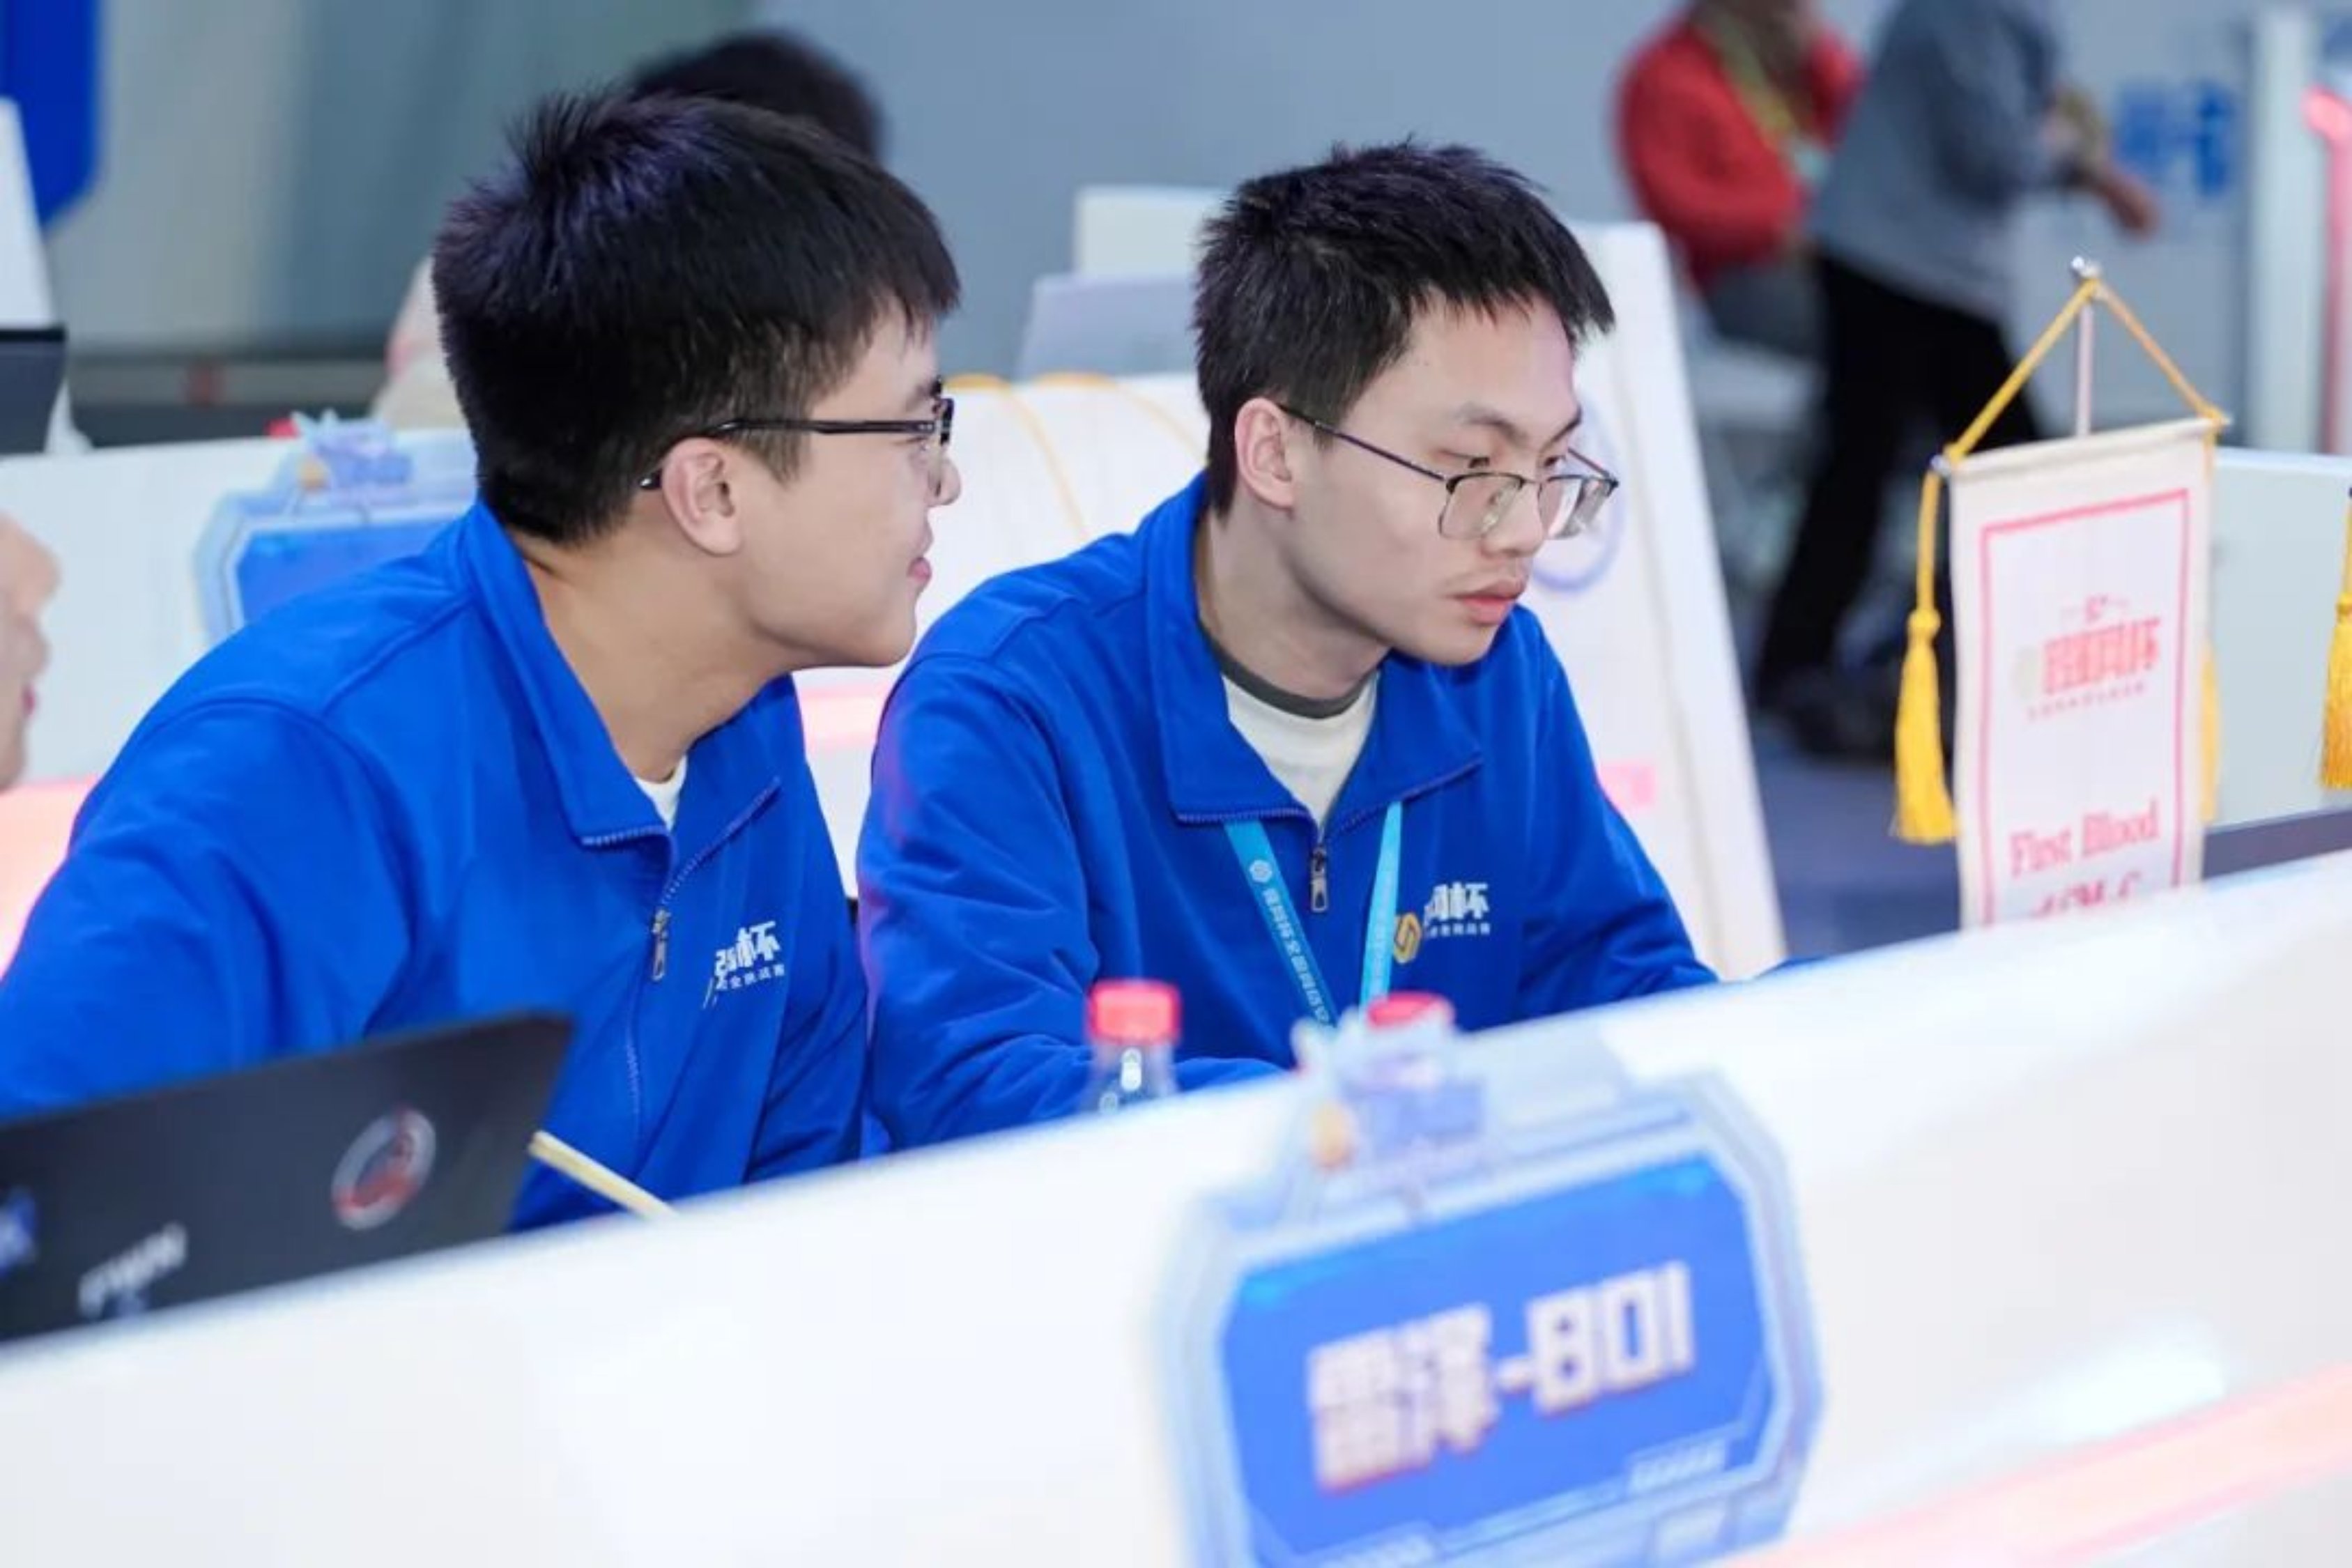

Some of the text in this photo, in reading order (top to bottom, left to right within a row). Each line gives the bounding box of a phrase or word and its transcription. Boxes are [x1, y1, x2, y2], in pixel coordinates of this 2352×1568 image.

[2010, 797, 2160, 880] First Blood
[1307, 1260, 1694, 1495] 雷泽-801
